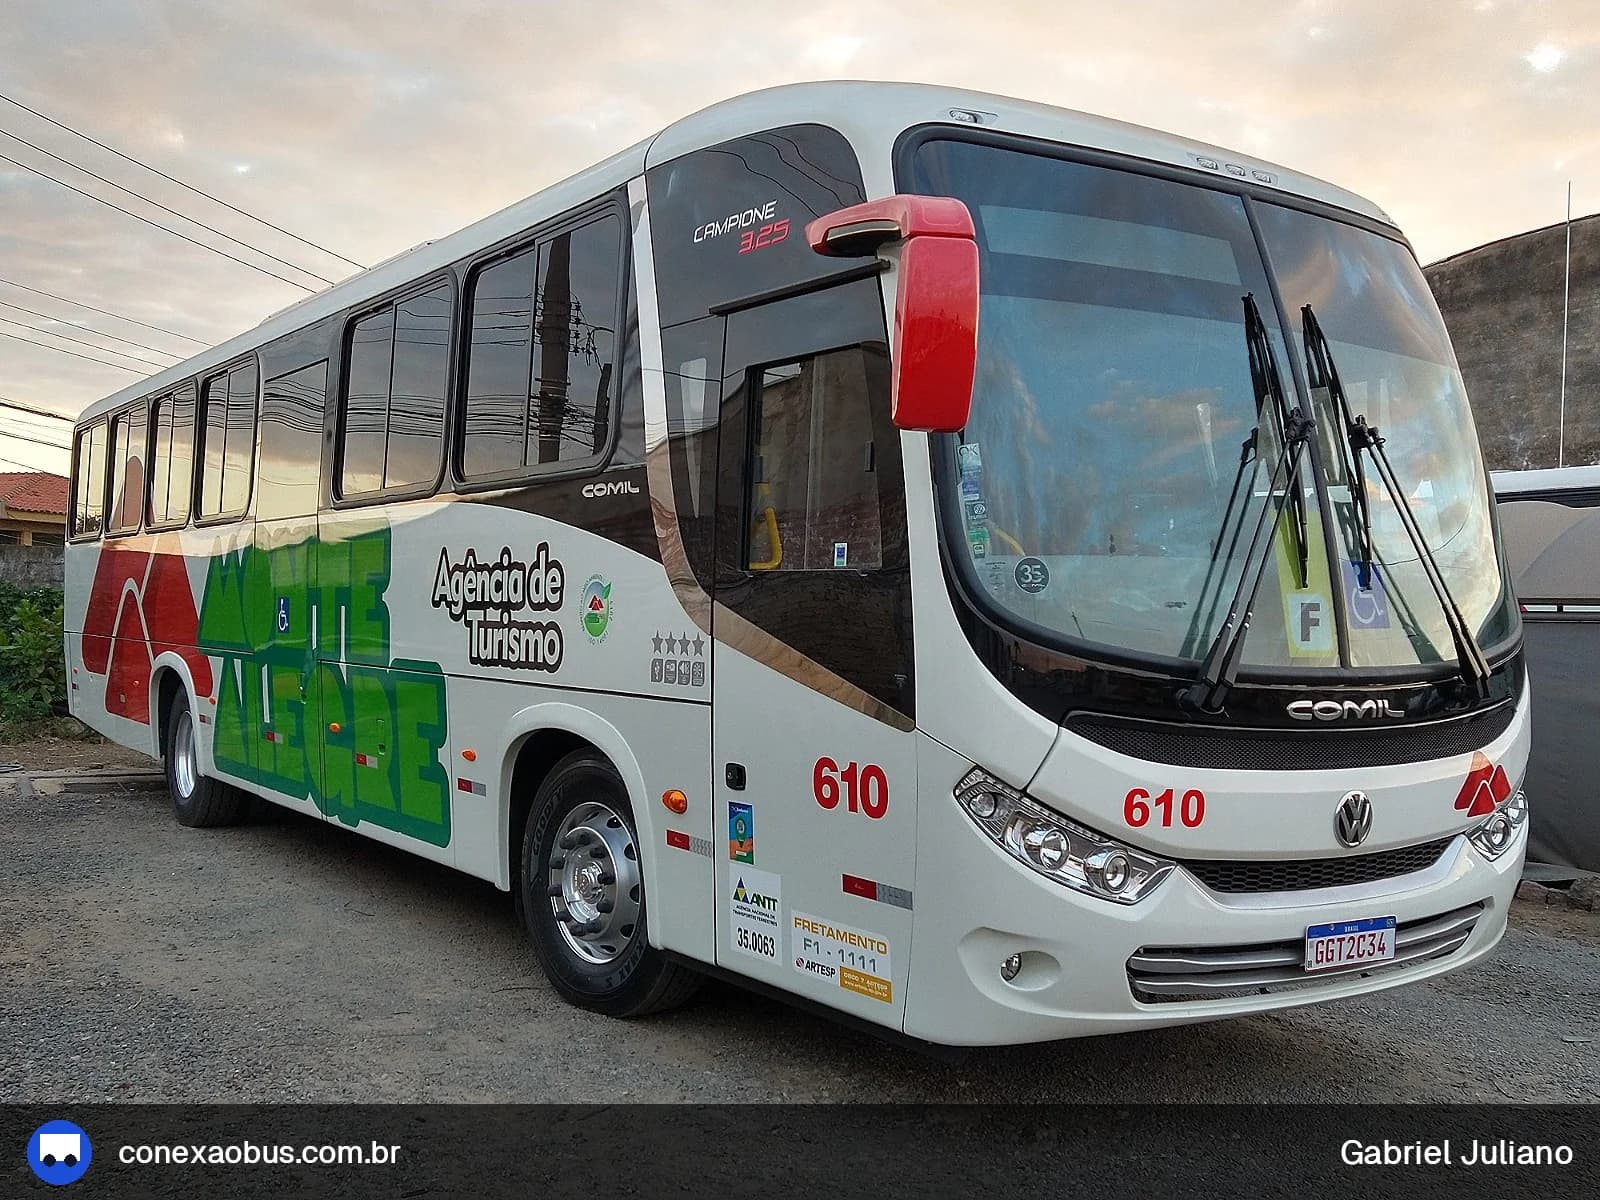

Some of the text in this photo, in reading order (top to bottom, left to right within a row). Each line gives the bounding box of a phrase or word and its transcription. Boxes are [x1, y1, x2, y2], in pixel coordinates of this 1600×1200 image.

[693, 199, 778, 244] CAMPIONE
[738, 217, 791, 255] 3.25
[581, 480, 640, 498] COMIL
[197, 526, 390, 663] MONTE
[433, 548, 526, 620] Agência
[527, 542, 563, 610] de
[466, 607, 563, 671] Turismo
[1300, 602, 1321, 643] F
[1286, 699, 1405, 720] COMIL
[214, 656, 447, 838] ALEGRE
[812, 756, 890, 820] 610
[1123, 787, 1206, 829] 610
[750, 893, 778, 911] ANTT
[737, 927, 775, 957] 35.0063
[794, 917, 888, 955] FRETAMENTO
[803, 937, 820, 955] F1
[838, 949, 876, 973] 1111
[1315, 932, 1386, 965] GGT2C34
[805, 960, 836, 979] ARTESP
